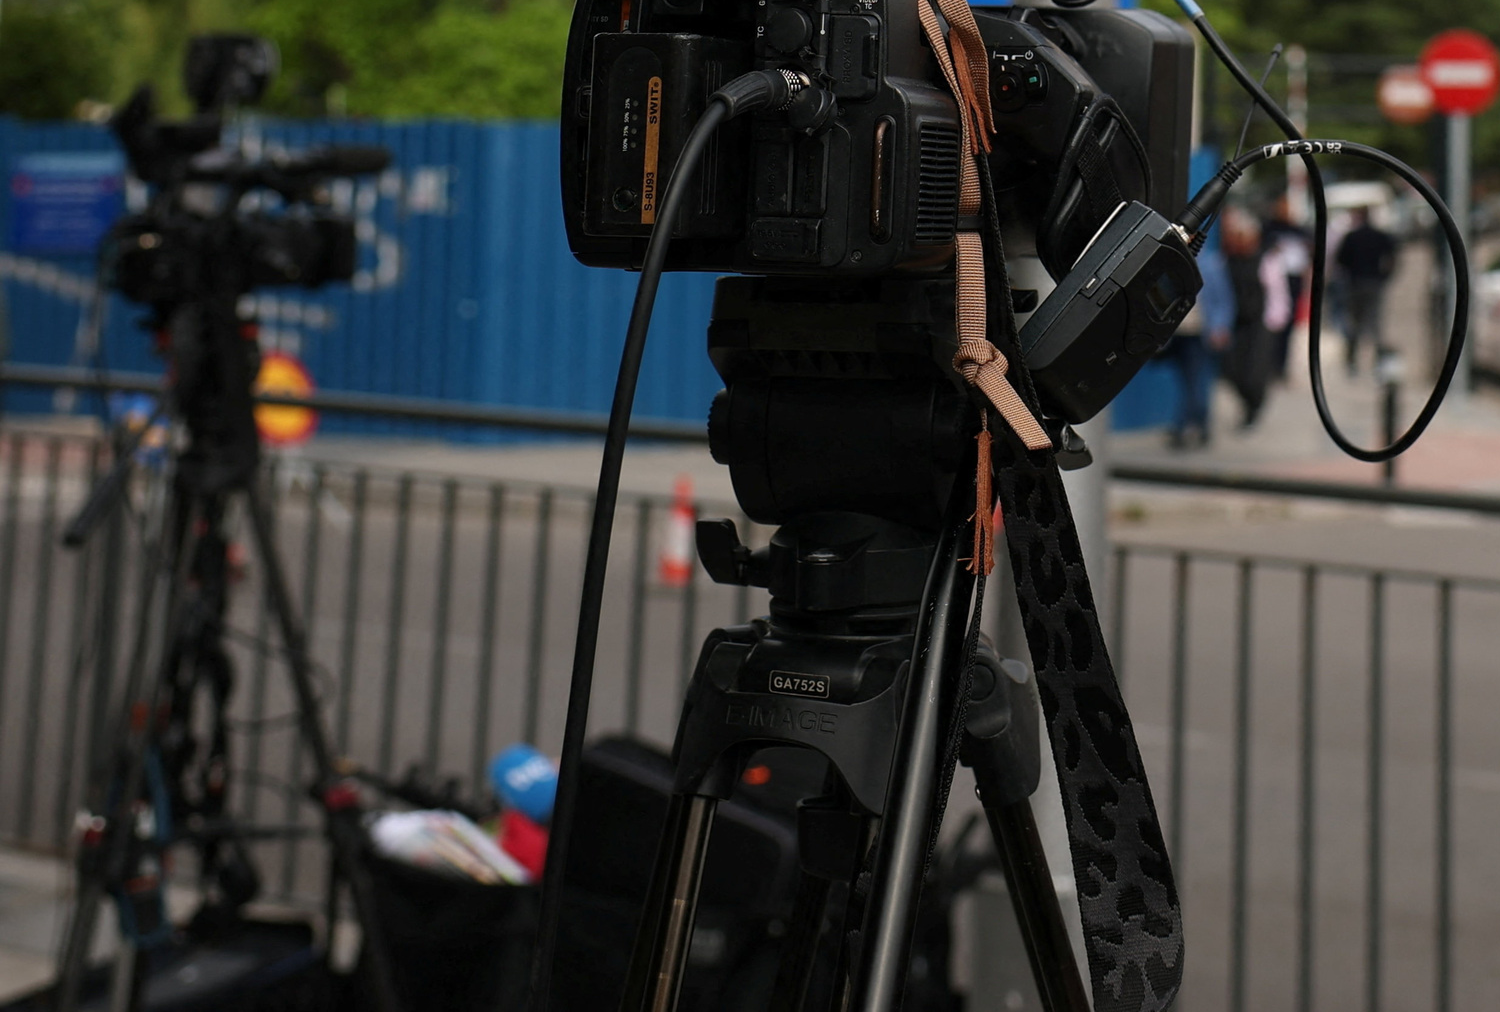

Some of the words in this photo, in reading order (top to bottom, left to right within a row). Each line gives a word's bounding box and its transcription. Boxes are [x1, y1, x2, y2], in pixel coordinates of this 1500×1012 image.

[757, 25, 765, 38] TC
[644, 172, 655, 211] S-8U93
[773, 676, 825, 693] GA752S
